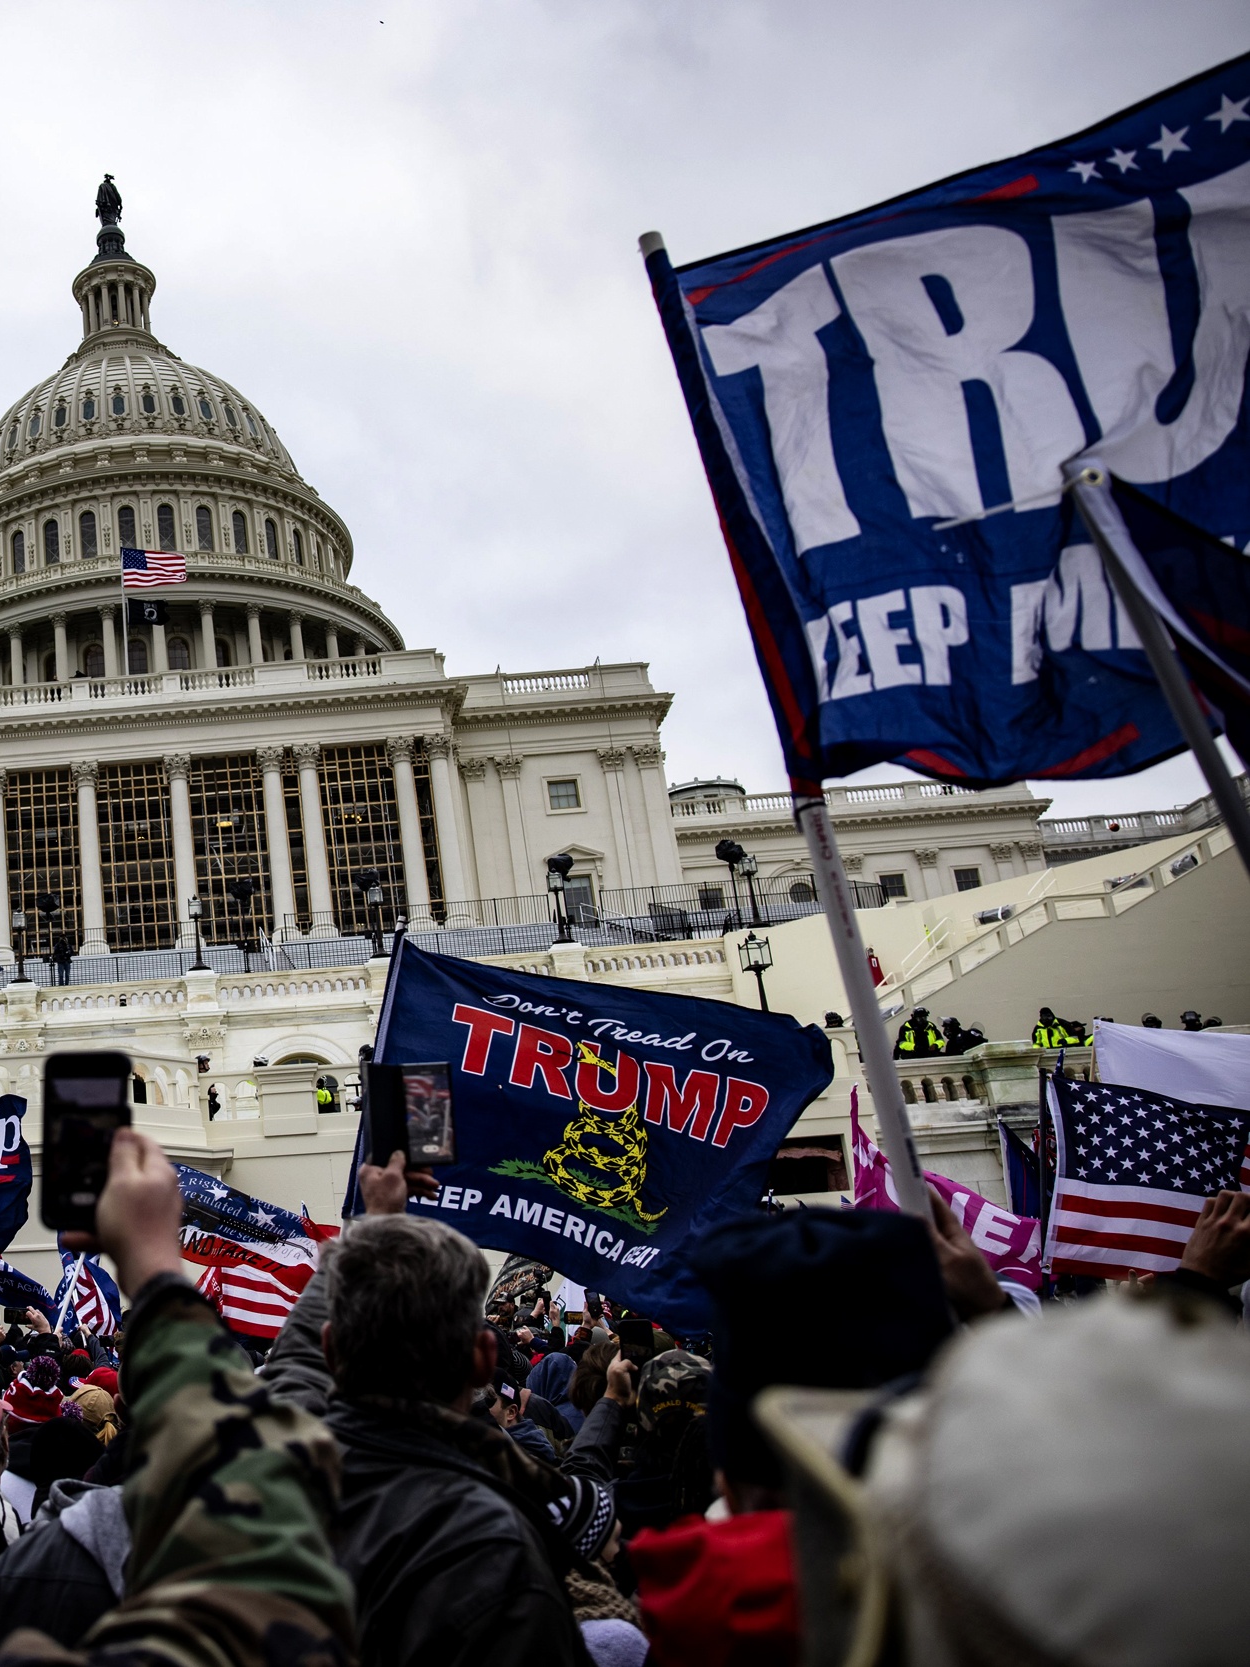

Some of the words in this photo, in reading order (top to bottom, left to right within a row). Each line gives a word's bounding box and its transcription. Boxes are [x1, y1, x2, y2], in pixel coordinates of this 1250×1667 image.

[482, 994, 582, 1025] Don't
[588, 1017, 692, 1050] Tread
[701, 1039, 755, 1063] On
[452, 1003, 770, 1148] TRUMP
[489, 1193, 625, 1262] AMERICA
[652, 1399, 682, 1413] DONALD
